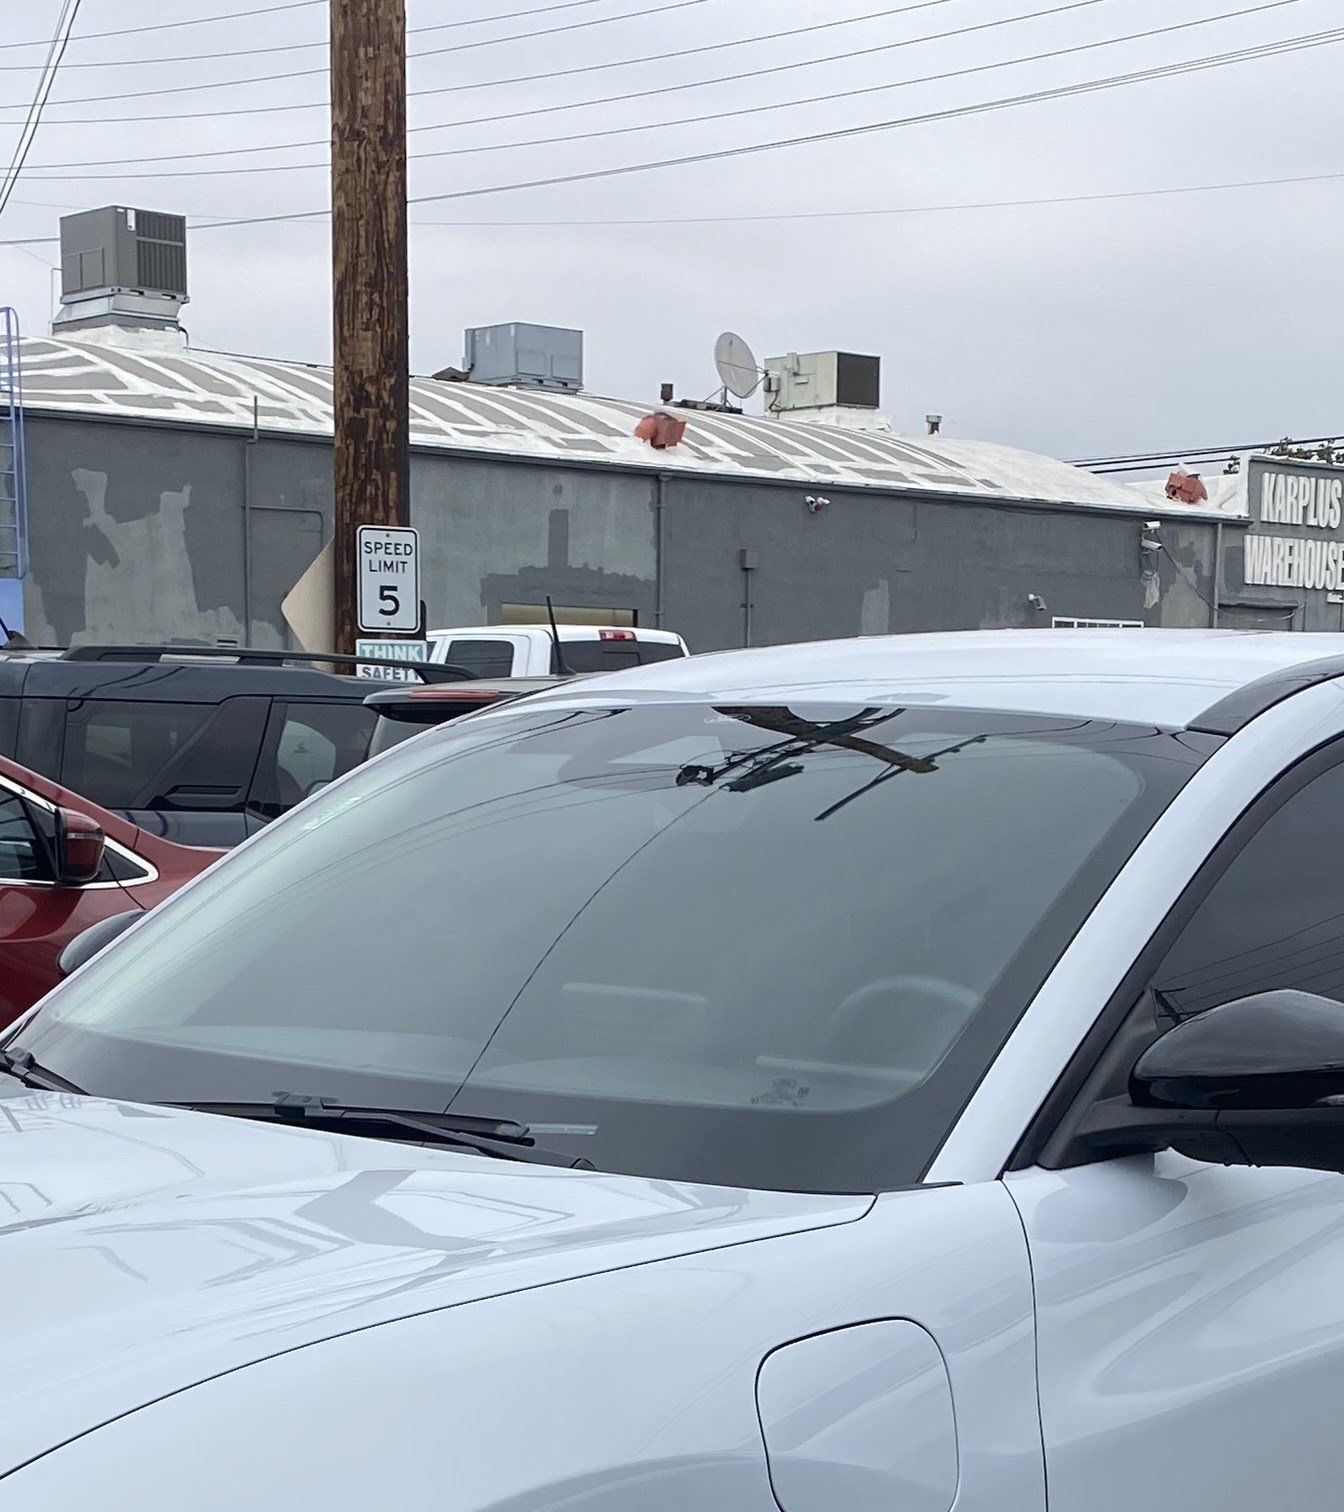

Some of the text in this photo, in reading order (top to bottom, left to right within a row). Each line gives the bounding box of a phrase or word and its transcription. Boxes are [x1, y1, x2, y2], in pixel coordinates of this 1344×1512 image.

[1260, 472, 1342, 529] KARPLUS
[363, 541, 413, 556] SPEED
[369, 559, 408, 575] LIMIT
[378, 585, 400, 616] 5
[361, 644, 422, 662] THINK
